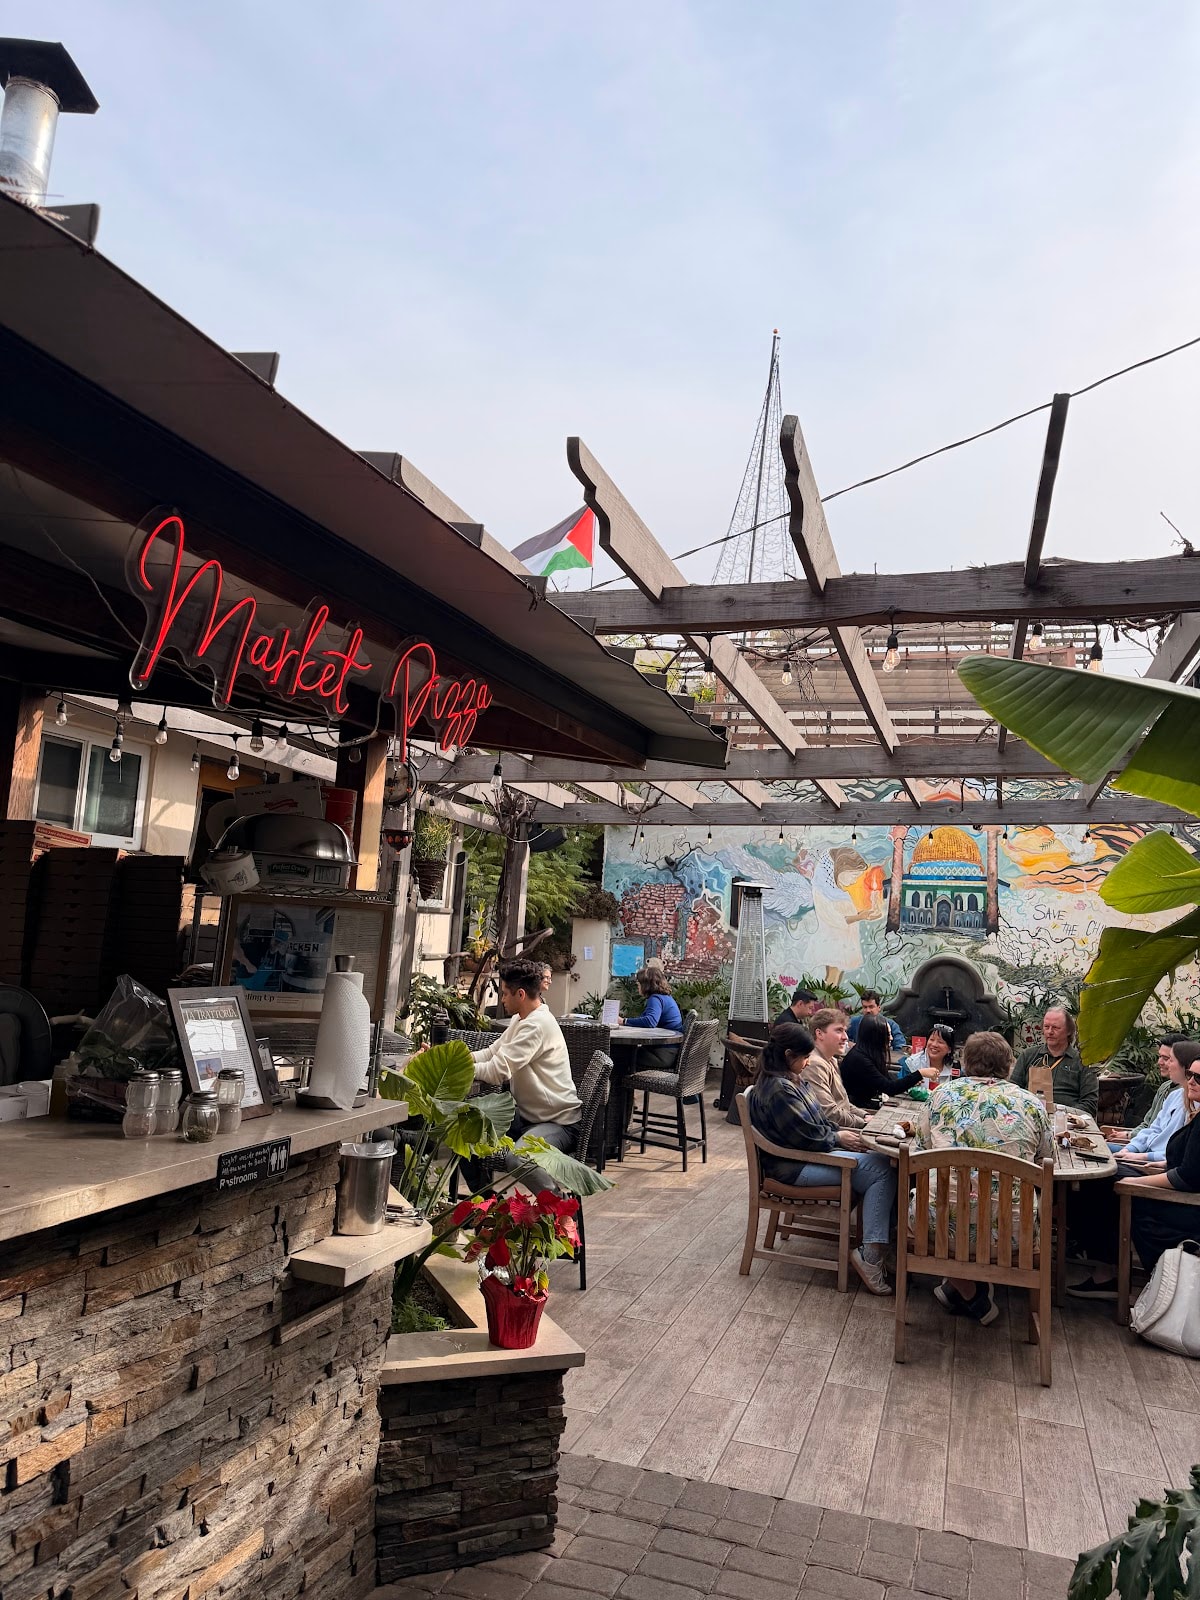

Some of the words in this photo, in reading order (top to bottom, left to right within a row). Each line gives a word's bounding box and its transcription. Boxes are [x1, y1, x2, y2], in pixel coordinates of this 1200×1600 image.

[139, 517, 372, 713] Market
[388, 643, 492, 762] Pizza
[1033, 903, 1067, 921] SAVE
[1061, 922, 1079, 936] THE
[245, 993, 262, 1003] ling
[194, 1008, 238, 1020] TRATTORIA
